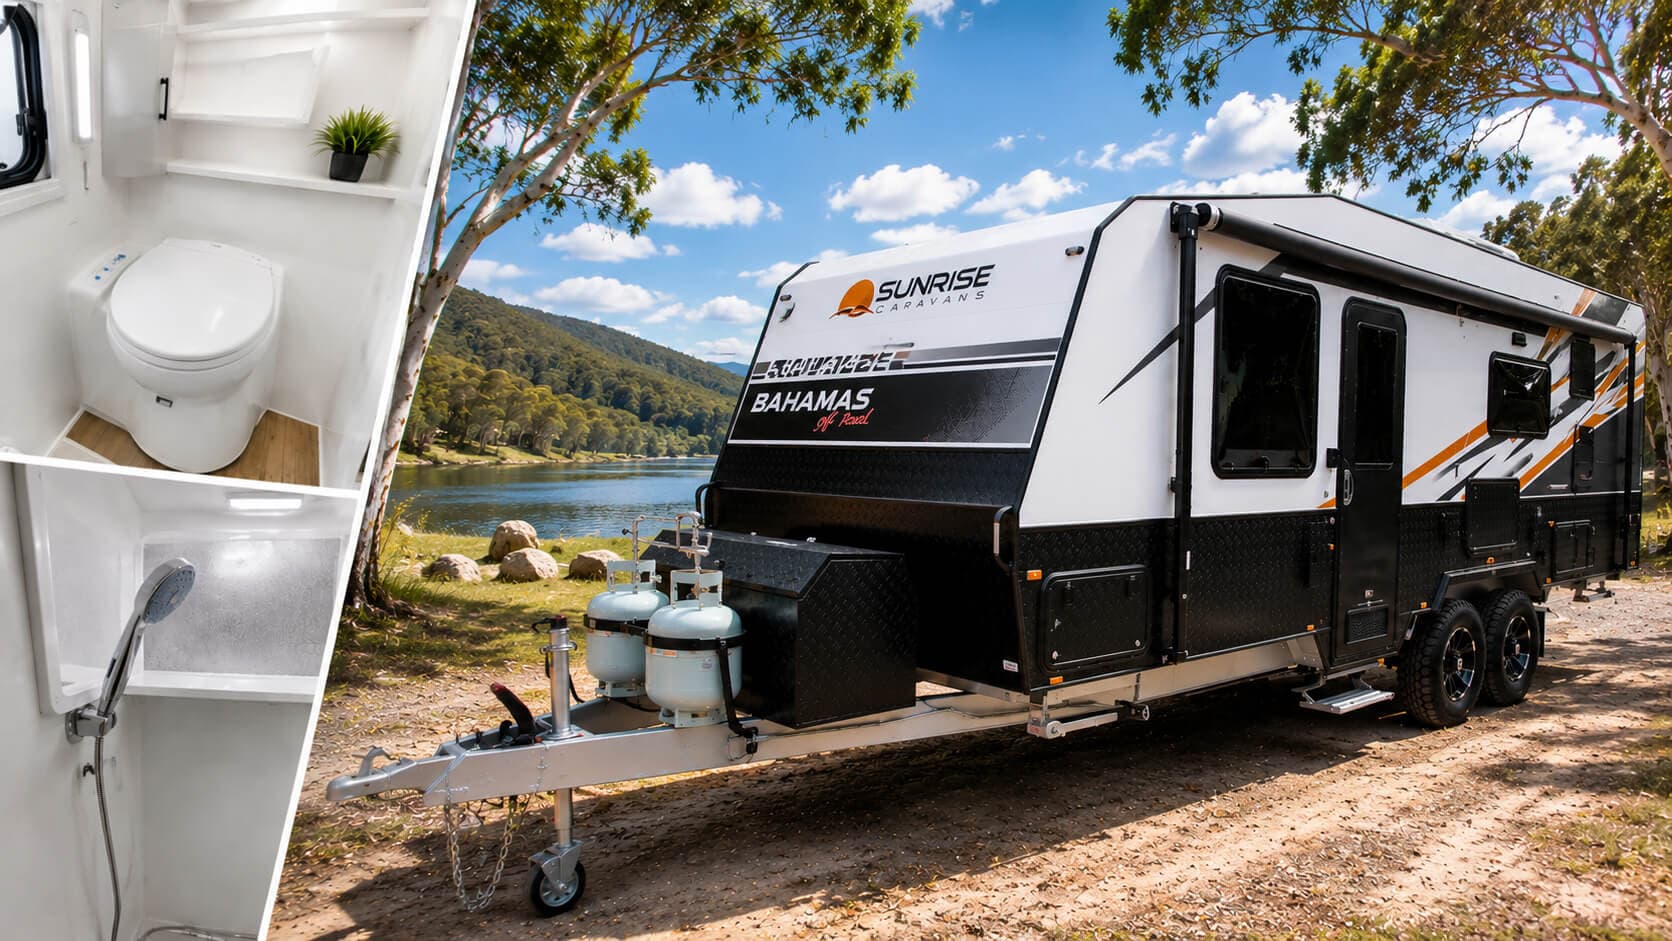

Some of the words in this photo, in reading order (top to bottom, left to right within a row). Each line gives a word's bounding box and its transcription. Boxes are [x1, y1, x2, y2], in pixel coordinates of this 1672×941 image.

[876, 264, 996, 302] SUNRISE
[875, 291, 985, 314] CARAVANS
[750, 388, 874, 413] BAHAMAS
